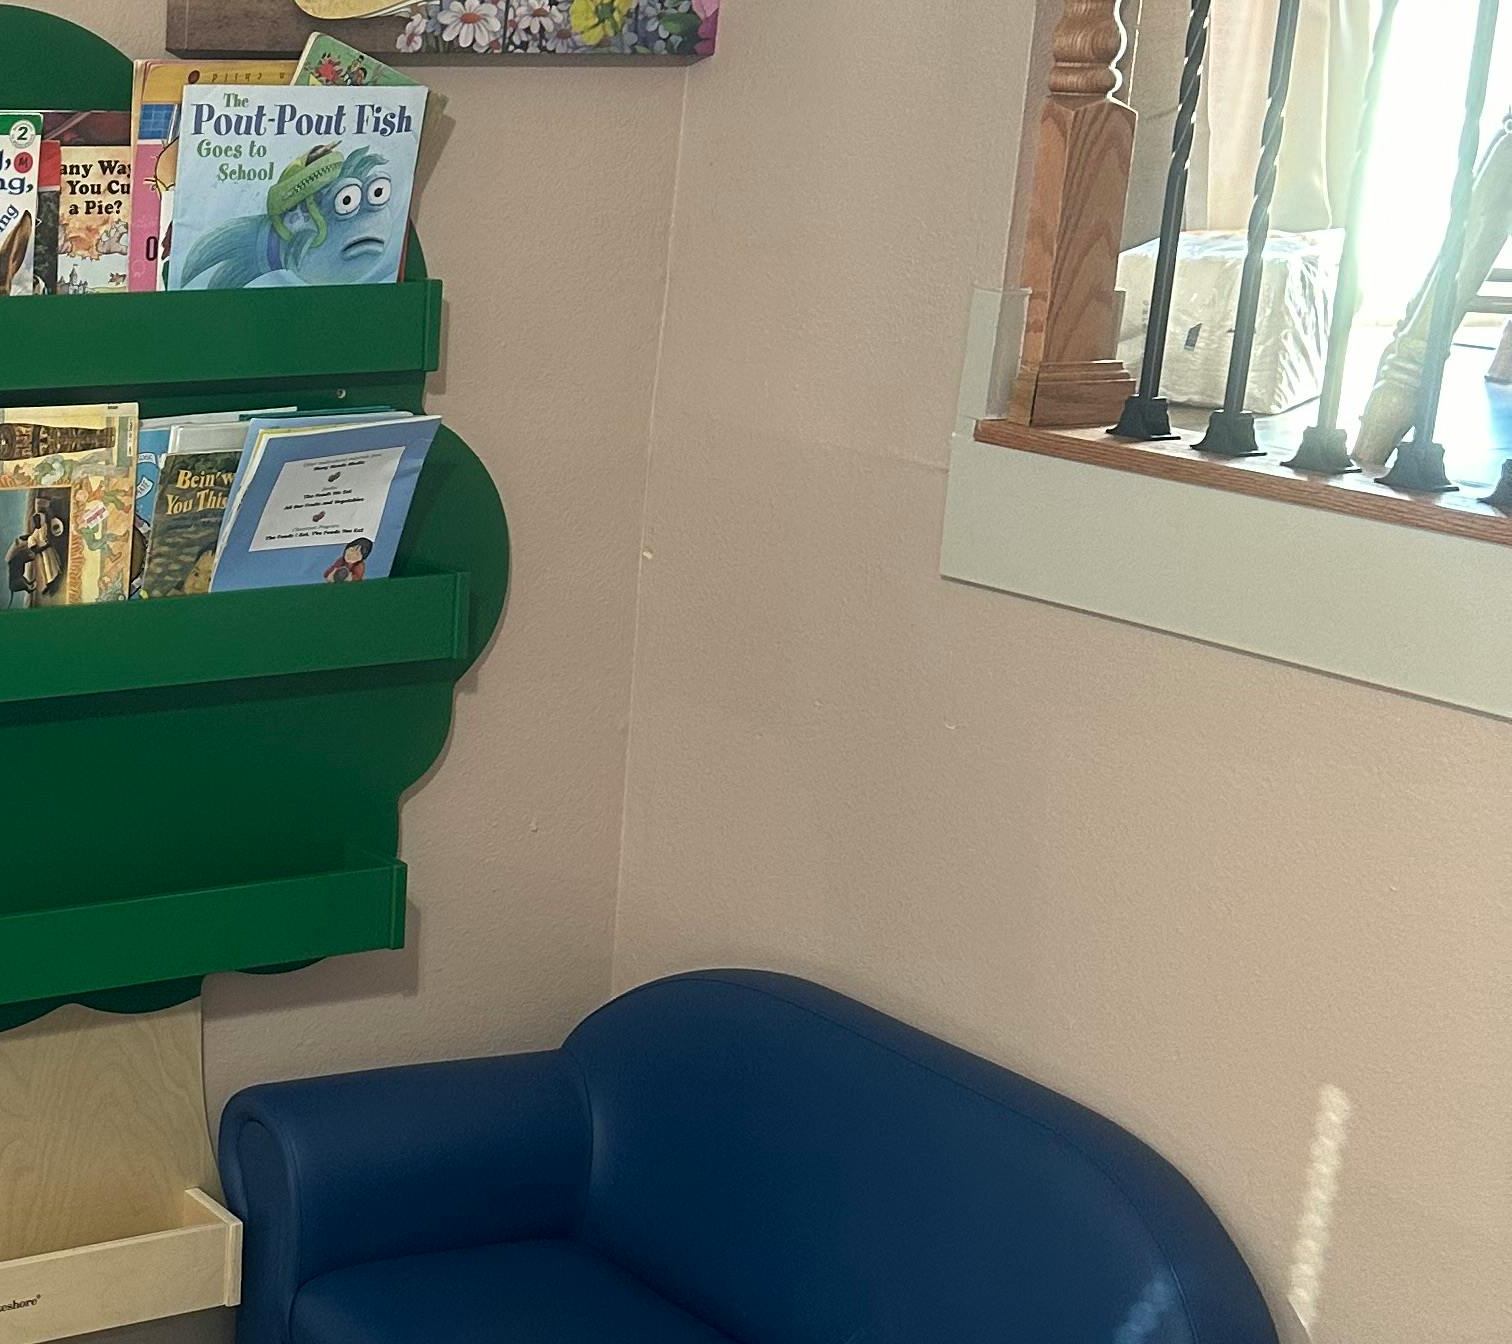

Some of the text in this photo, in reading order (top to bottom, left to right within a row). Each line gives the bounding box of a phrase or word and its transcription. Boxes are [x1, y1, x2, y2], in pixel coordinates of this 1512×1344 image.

[223, 93, 249, 108] The
[190, 103, 413, 137] Pout-Pout Fish
[16, 126, 29, 141] 2
[196, 138, 267, 159] Goes to
[216, 161, 274, 182] School
[66, 180, 101, 195] You
[69, 200, 122, 215] a Pie?
[166, 494, 193, 515] You
